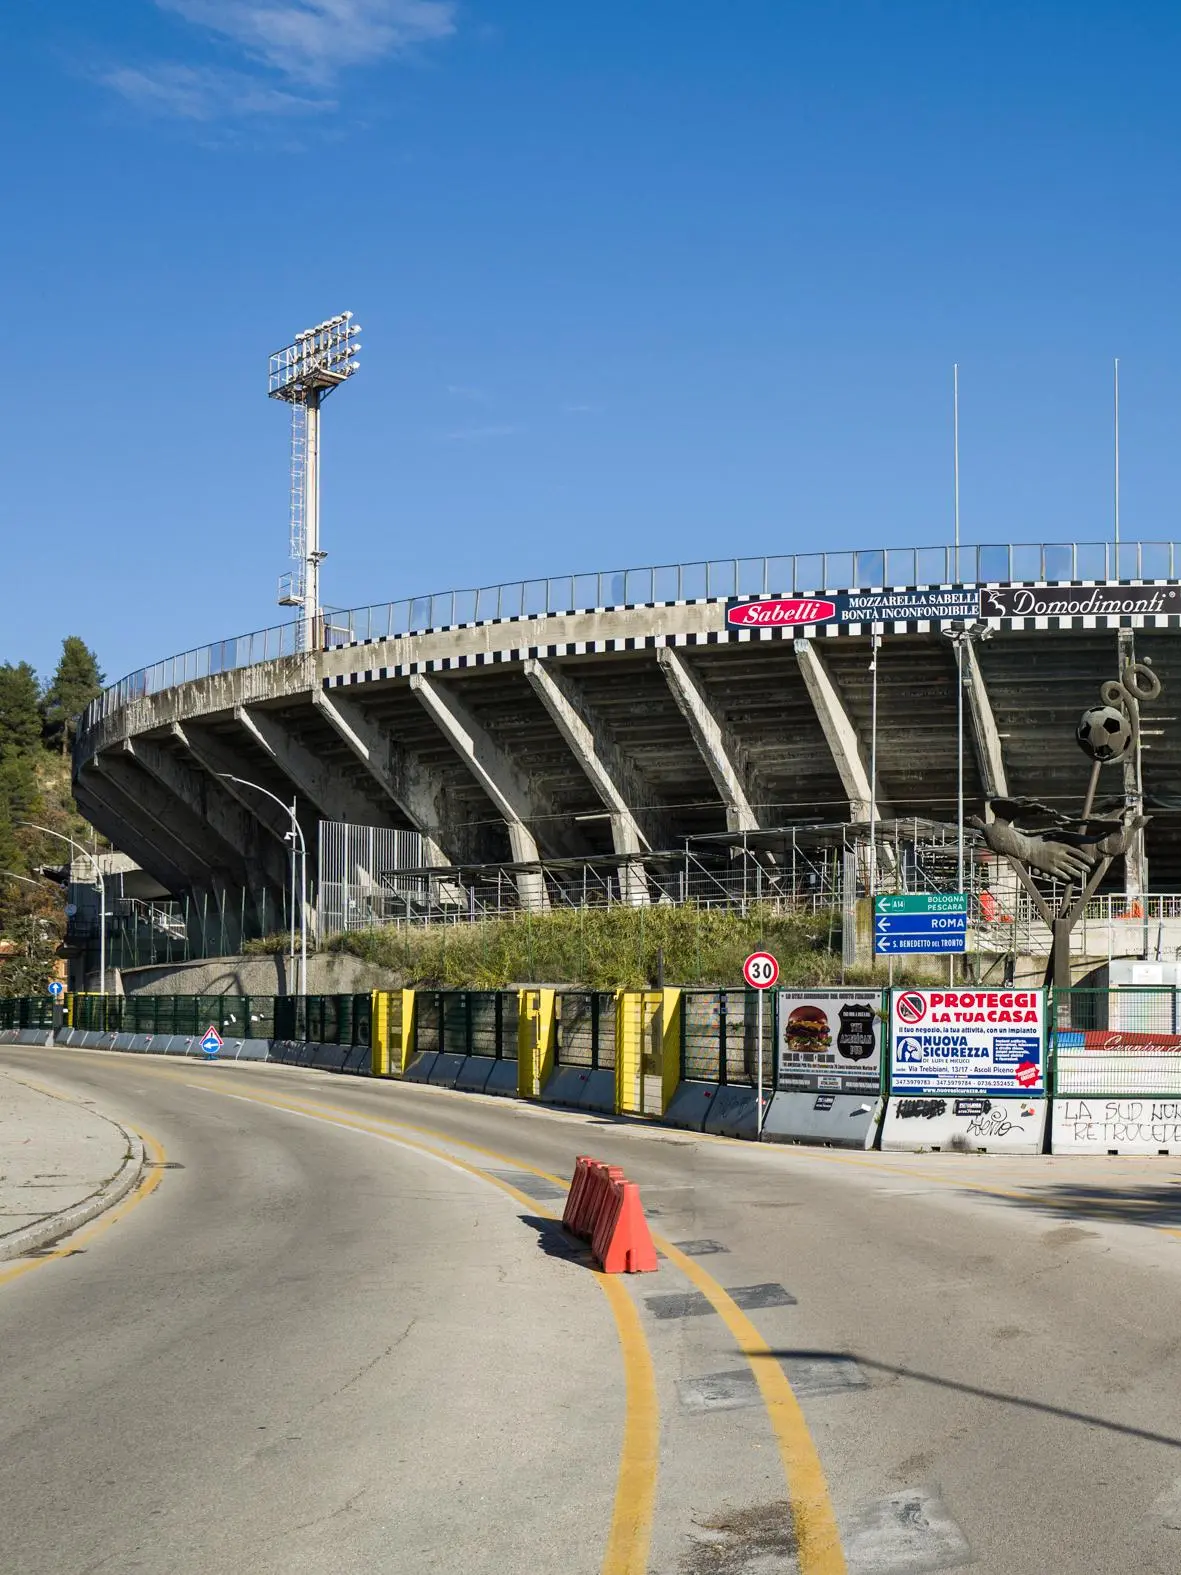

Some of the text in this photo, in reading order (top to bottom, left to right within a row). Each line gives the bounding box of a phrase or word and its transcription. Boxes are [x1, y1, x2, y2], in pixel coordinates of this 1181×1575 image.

[849, 592, 979, 608] MOZZARELLA SABELLI
[1012, 588, 1165, 615] Domodimonti
[743, 602, 820, 624] Sabelli
[841, 604, 980, 621] BONTÀ INCONFONDIBILE
[893, 900, 905, 908] A14
[927, 895, 965, 903] BOLOGNA
[927, 903, 963, 911] PESCARA
[931, 918, 965, 928] ROMA
[900, 939, 931, 948] BENEDETTO
[941, 939, 963, 947] TRONTO
[751, 963, 772, 979] 30
[930, 993, 1037, 1008] PROTEGGI
[932, 1010, 1038, 1022] LA TUA CASA
[1008, 1027, 1037, 1035] impianto
[923, 1036, 968, 1047] NUOVA
[923, 1047, 990, 1058] SICUREZZA
[1065, 1100, 1092, 1120] LA
[1105, 1102, 1143, 1121] SUD
